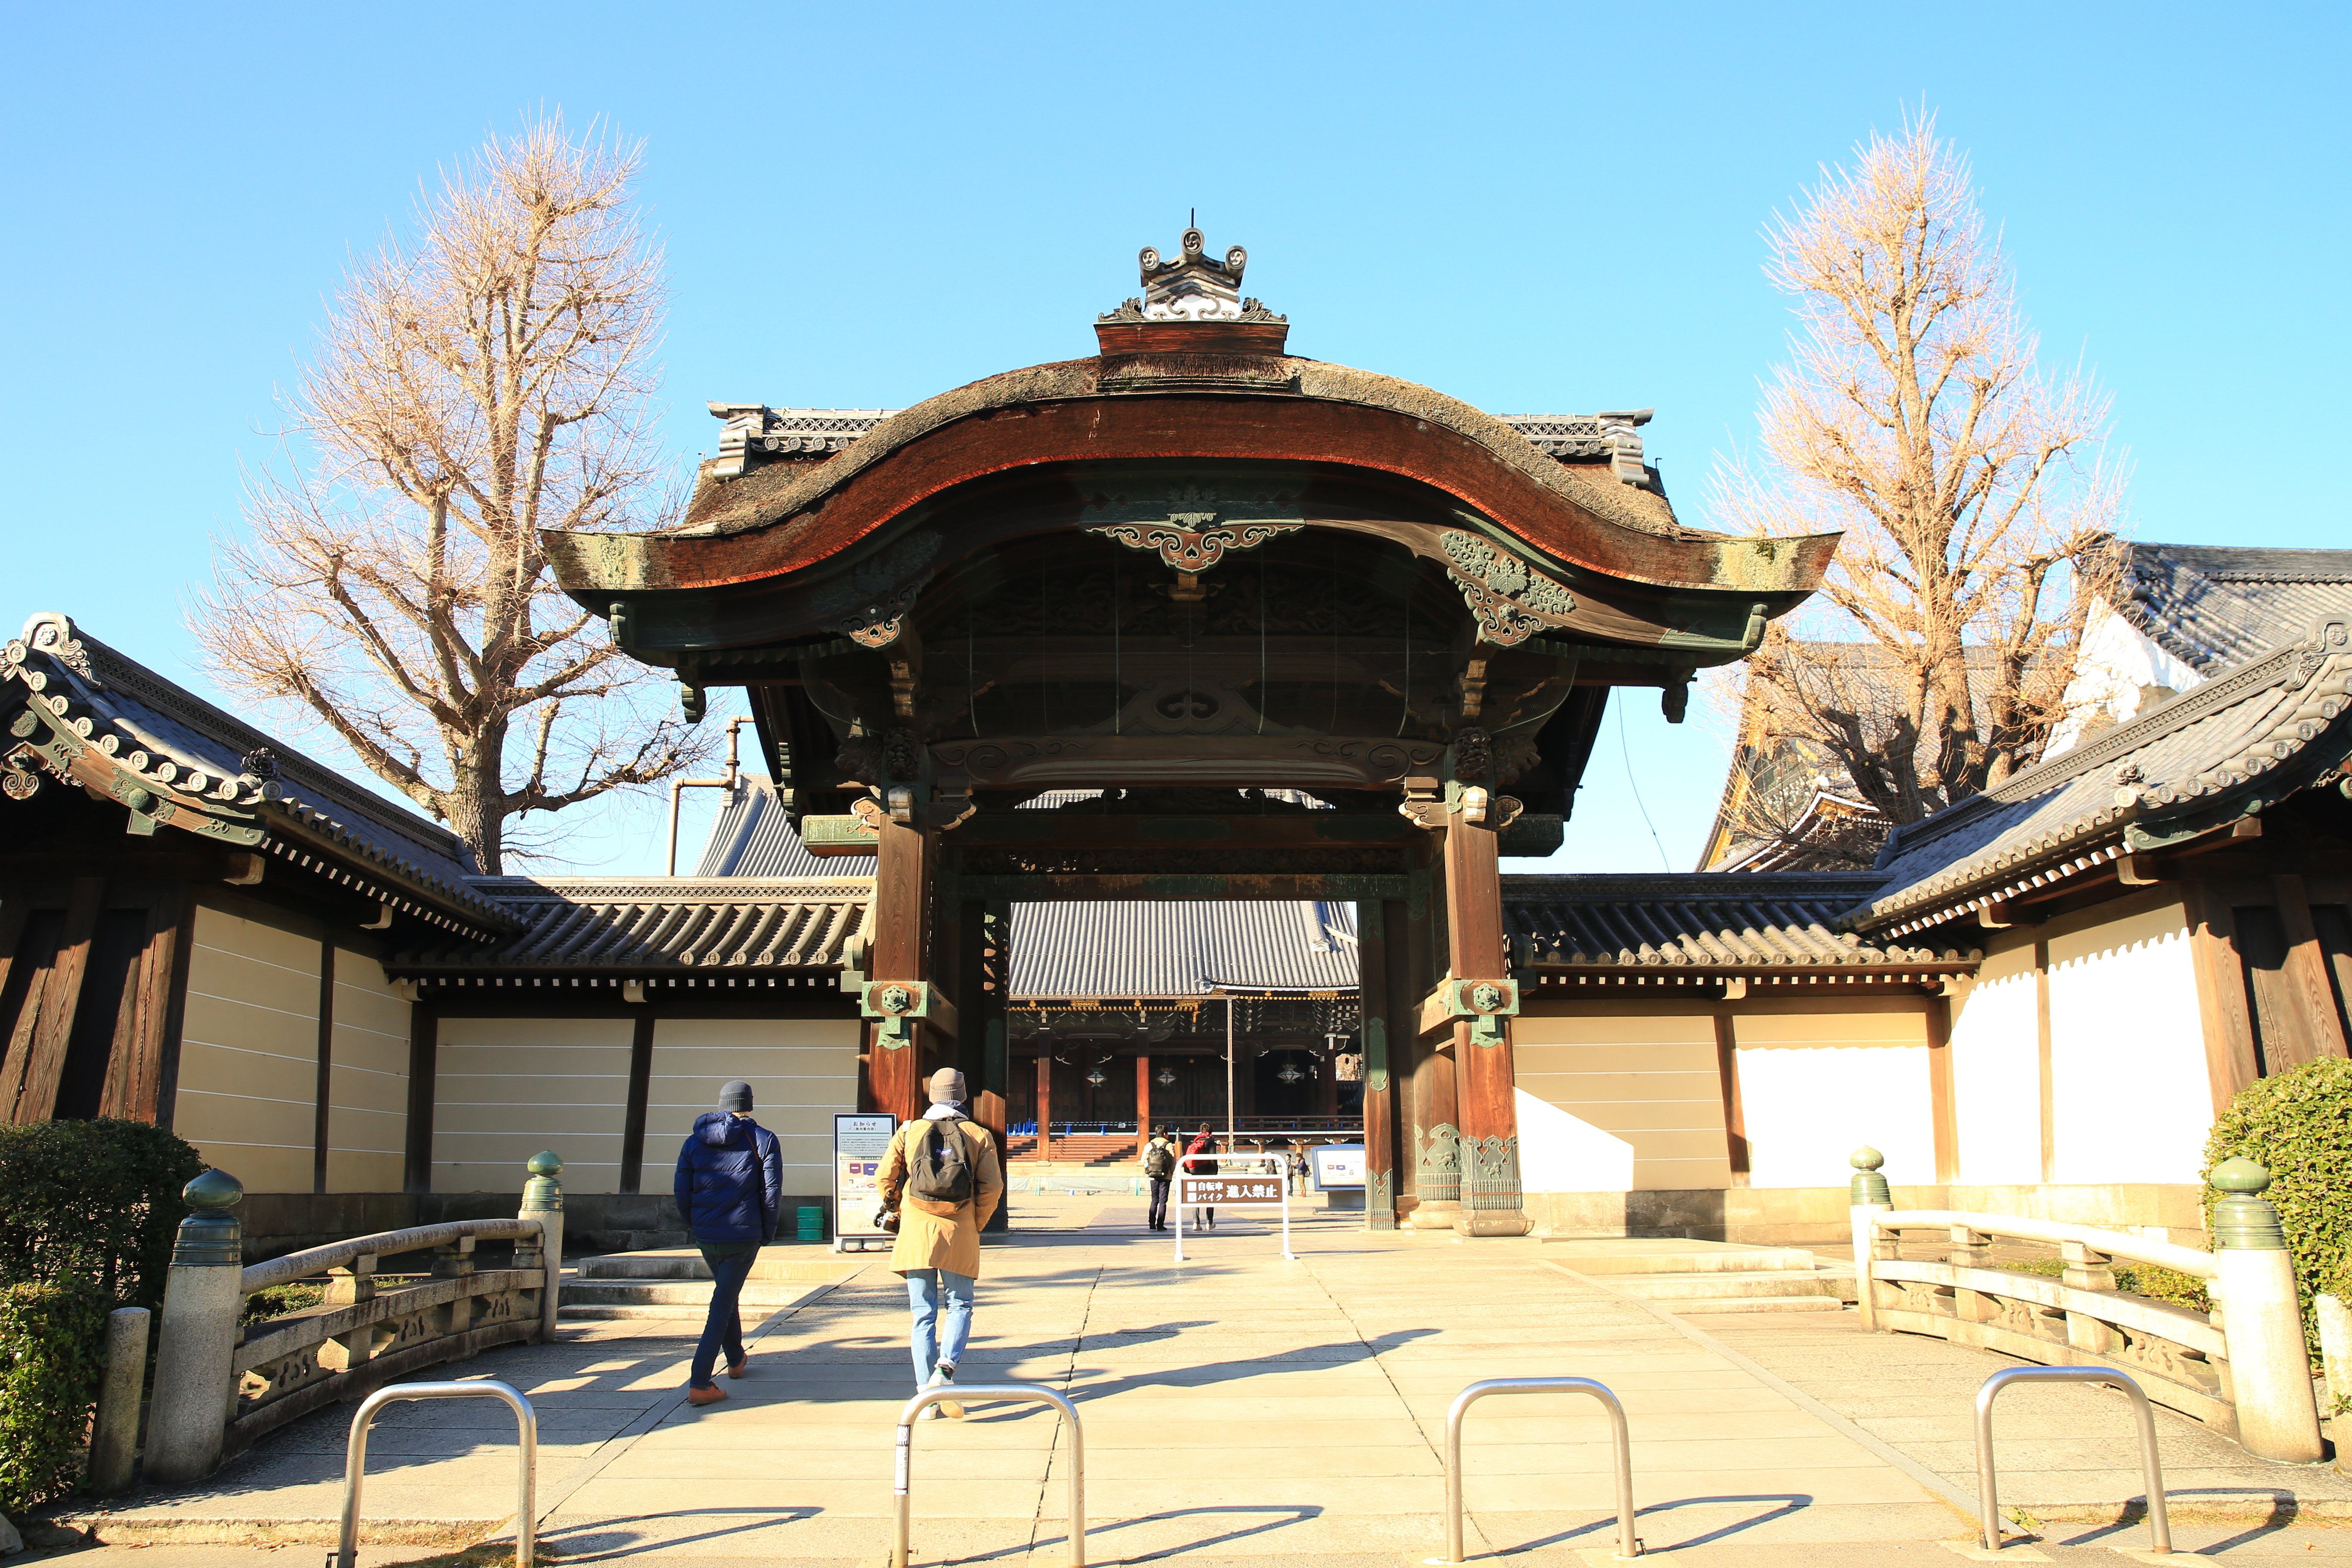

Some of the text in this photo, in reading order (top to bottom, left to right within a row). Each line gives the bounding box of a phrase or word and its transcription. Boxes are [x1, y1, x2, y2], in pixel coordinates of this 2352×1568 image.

[1198, 1182, 1223, 1191] 自転車
[1226, 1184, 1278, 1198] 進入禁止
[1197, 1193, 1223, 1202] バイク
